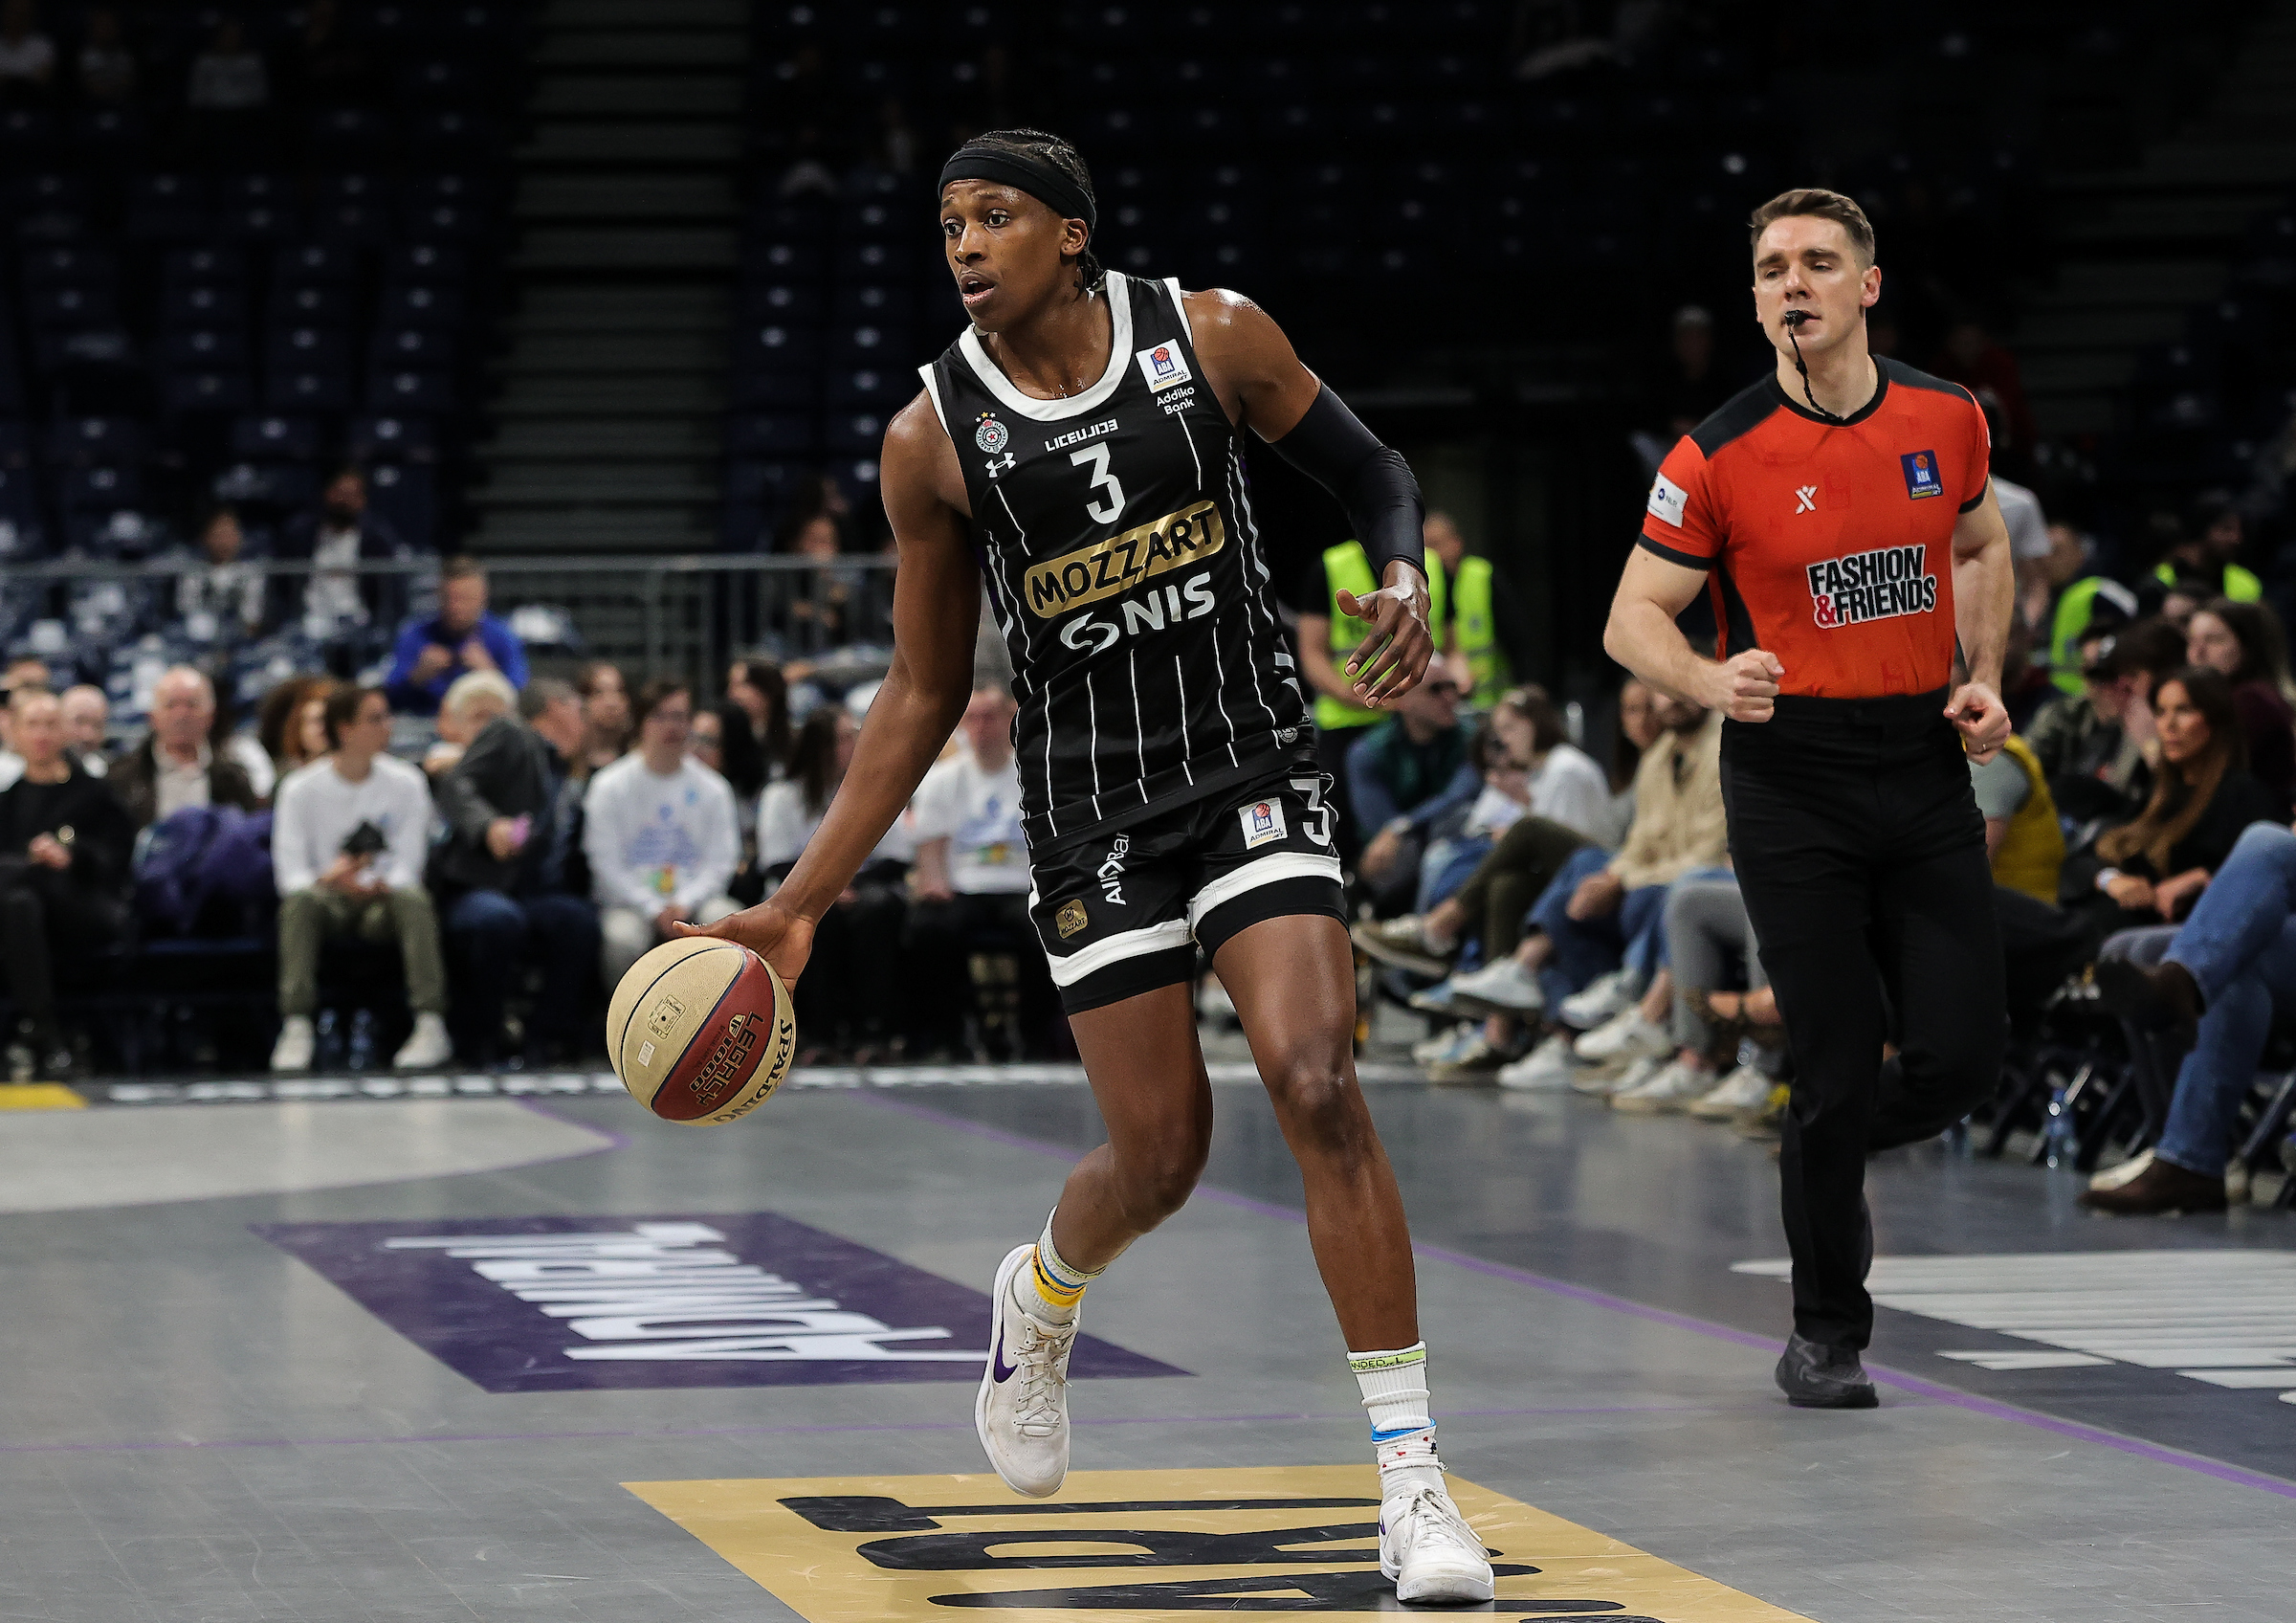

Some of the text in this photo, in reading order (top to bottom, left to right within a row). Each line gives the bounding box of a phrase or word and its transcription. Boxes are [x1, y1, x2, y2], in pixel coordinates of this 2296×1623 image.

[1153, 369, 1188, 385] ADMIRAL
[1157, 361, 1173, 375] ABA
[1157, 387, 1195, 407] Addiko
[1163, 398, 1195, 414] Bank
[1071, 441, 1127, 524] 3
[1030, 509, 1215, 613] MOZZART
[1807, 545, 1926, 596] FASHION
[1121, 571, 1216, 636] NIS
[1814, 576, 1936, 628] &FRIENDS
[1250, 828, 1284, 842] ADMIRAL
[1256, 817, 1271, 832] ABA
[1290, 778, 1331, 847] 3
[695, 1012, 764, 1106] LEGACY
[712, 1019, 793, 1123] SPALDING
